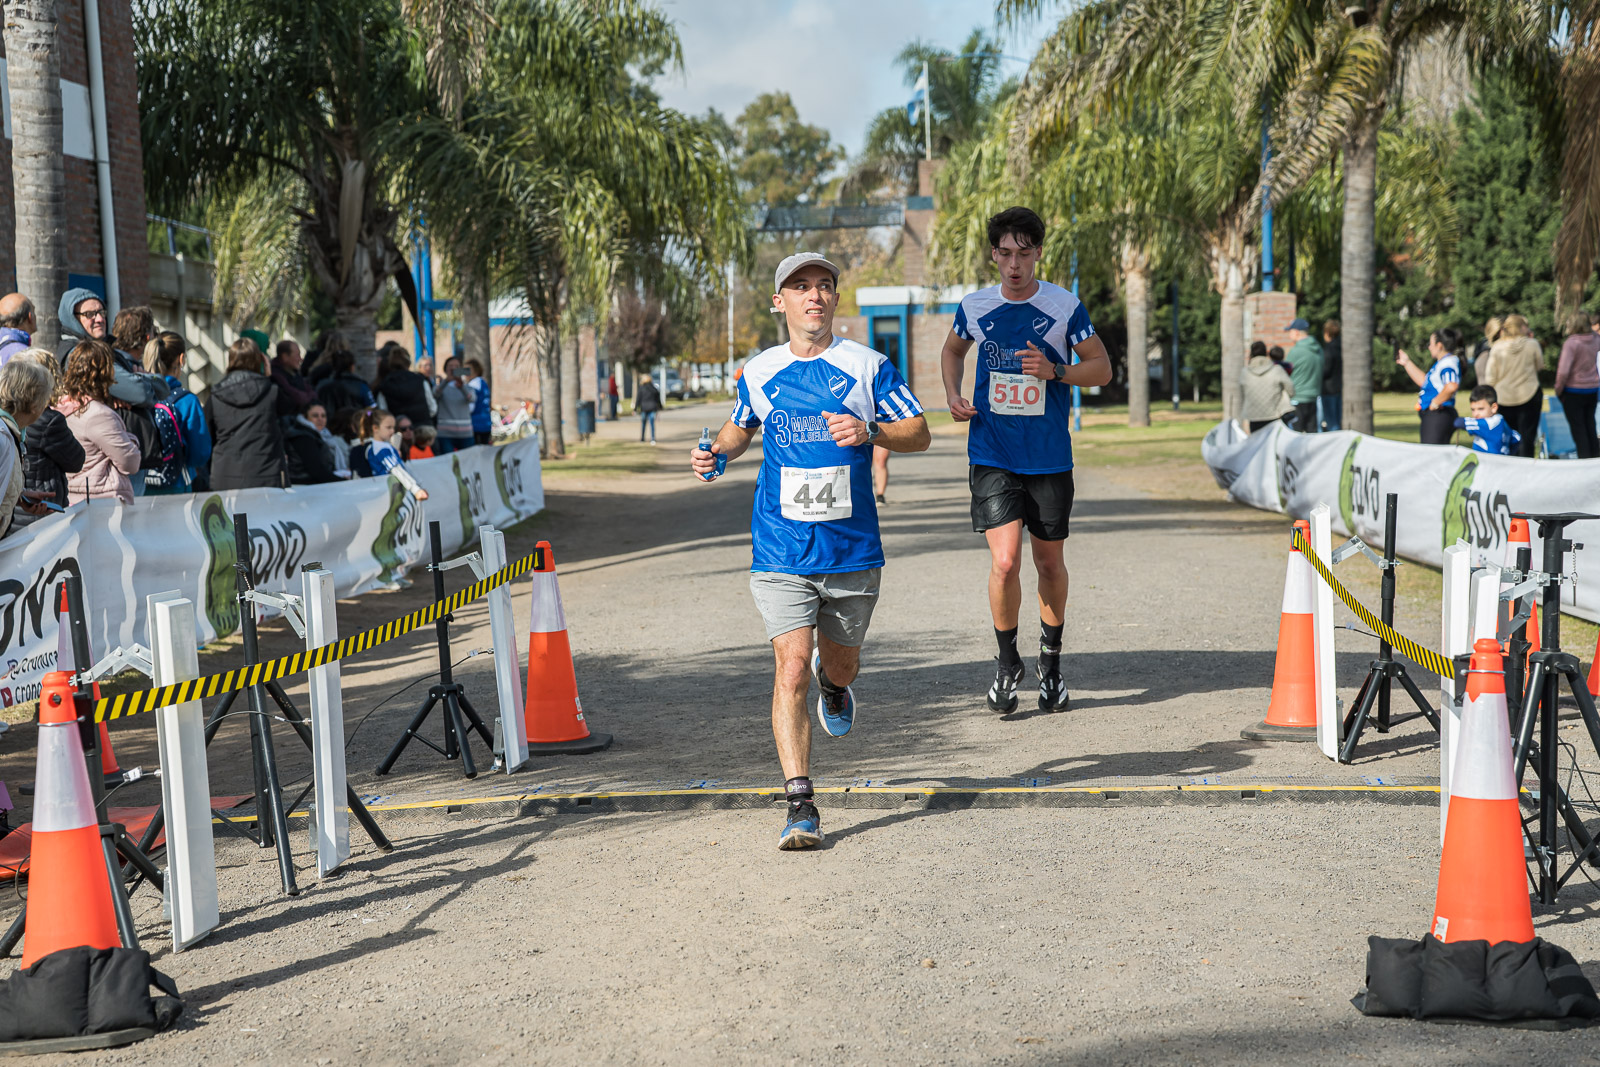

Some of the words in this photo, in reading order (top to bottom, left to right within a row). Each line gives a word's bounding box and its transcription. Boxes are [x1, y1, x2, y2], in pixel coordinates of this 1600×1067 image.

[983, 340, 1001, 370] 3
[993, 383, 1040, 405] 510
[771, 409, 791, 448] 3
[793, 482, 837, 509] 44
